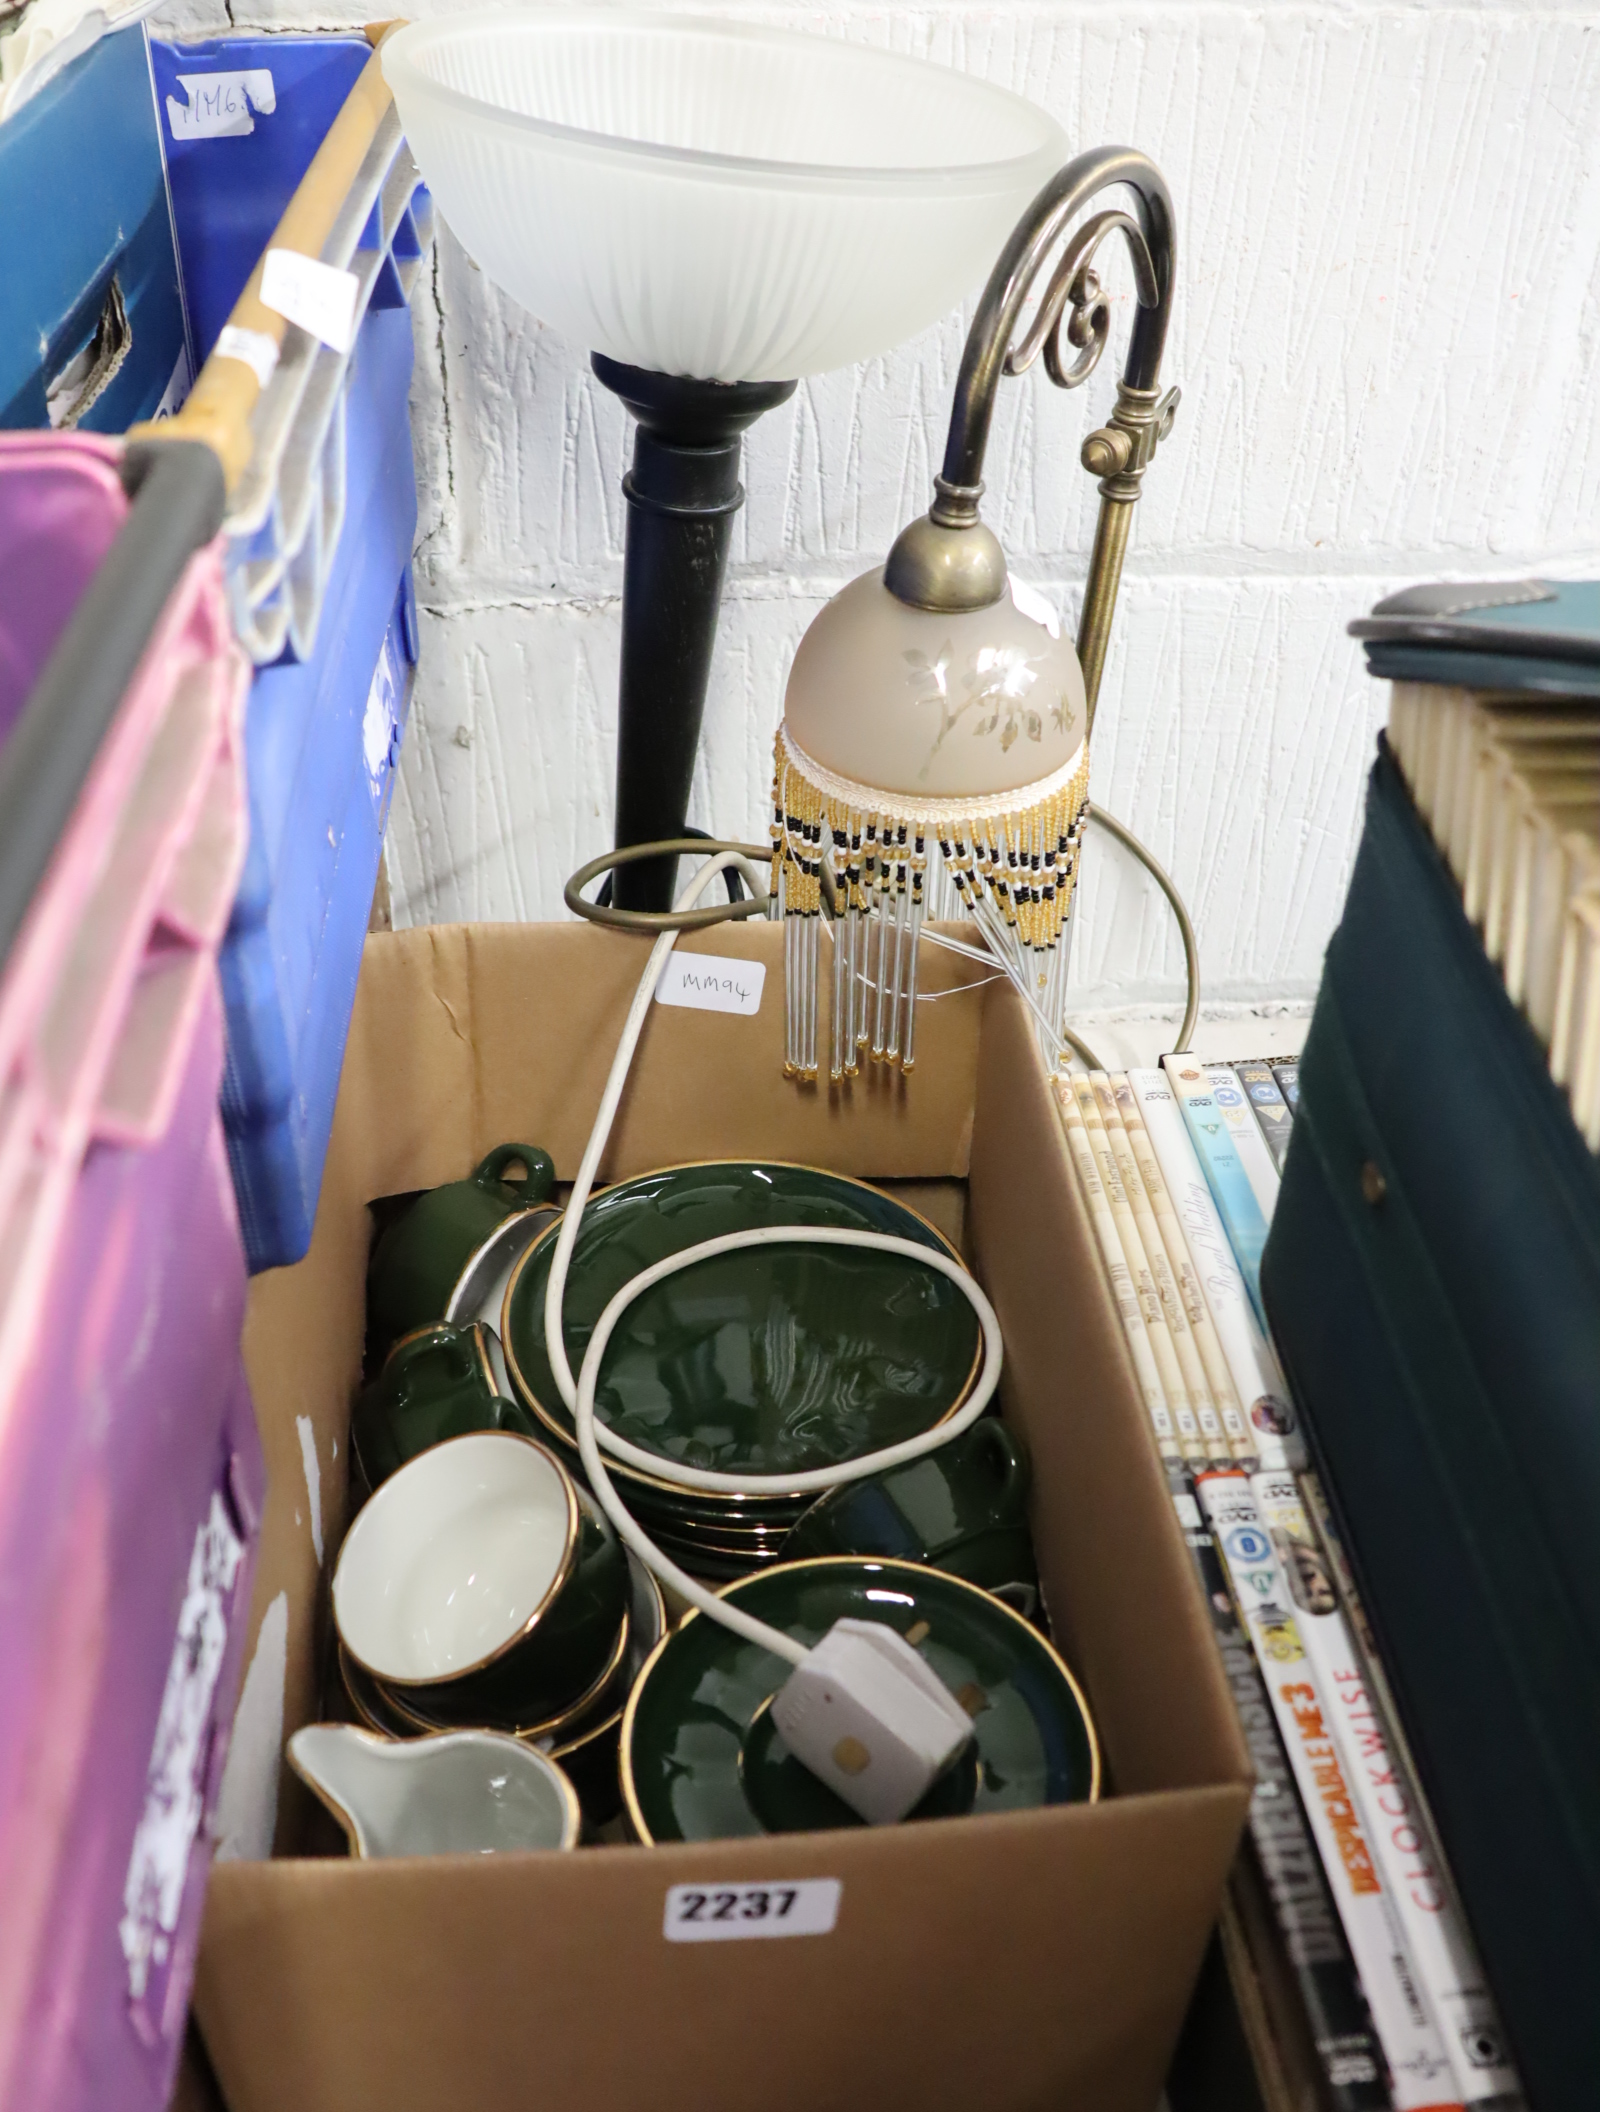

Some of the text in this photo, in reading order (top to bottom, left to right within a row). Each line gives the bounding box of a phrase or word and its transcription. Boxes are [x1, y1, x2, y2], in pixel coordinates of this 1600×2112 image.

[683, 973, 751, 1003] MM94
[1098, 1150, 1129, 1203] Clint Eastwood
[1184, 1182, 1216, 1243] Wedding
[1154, 1253, 1169, 1279] Blues
[1199, 1243, 1242, 1301] Royal
[1138, 1268, 1162, 1324] Piano Blues
[1218, 1513, 1257, 1523] DVD
[1264, 1486, 1299, 1499] DVD
[1279, 1682, 1382, 1895] DESPICABLE ME 3
[1333, 1669, 1447, 1912] CLOCKWISE
[679, 1889, 798, 1923] 2237
